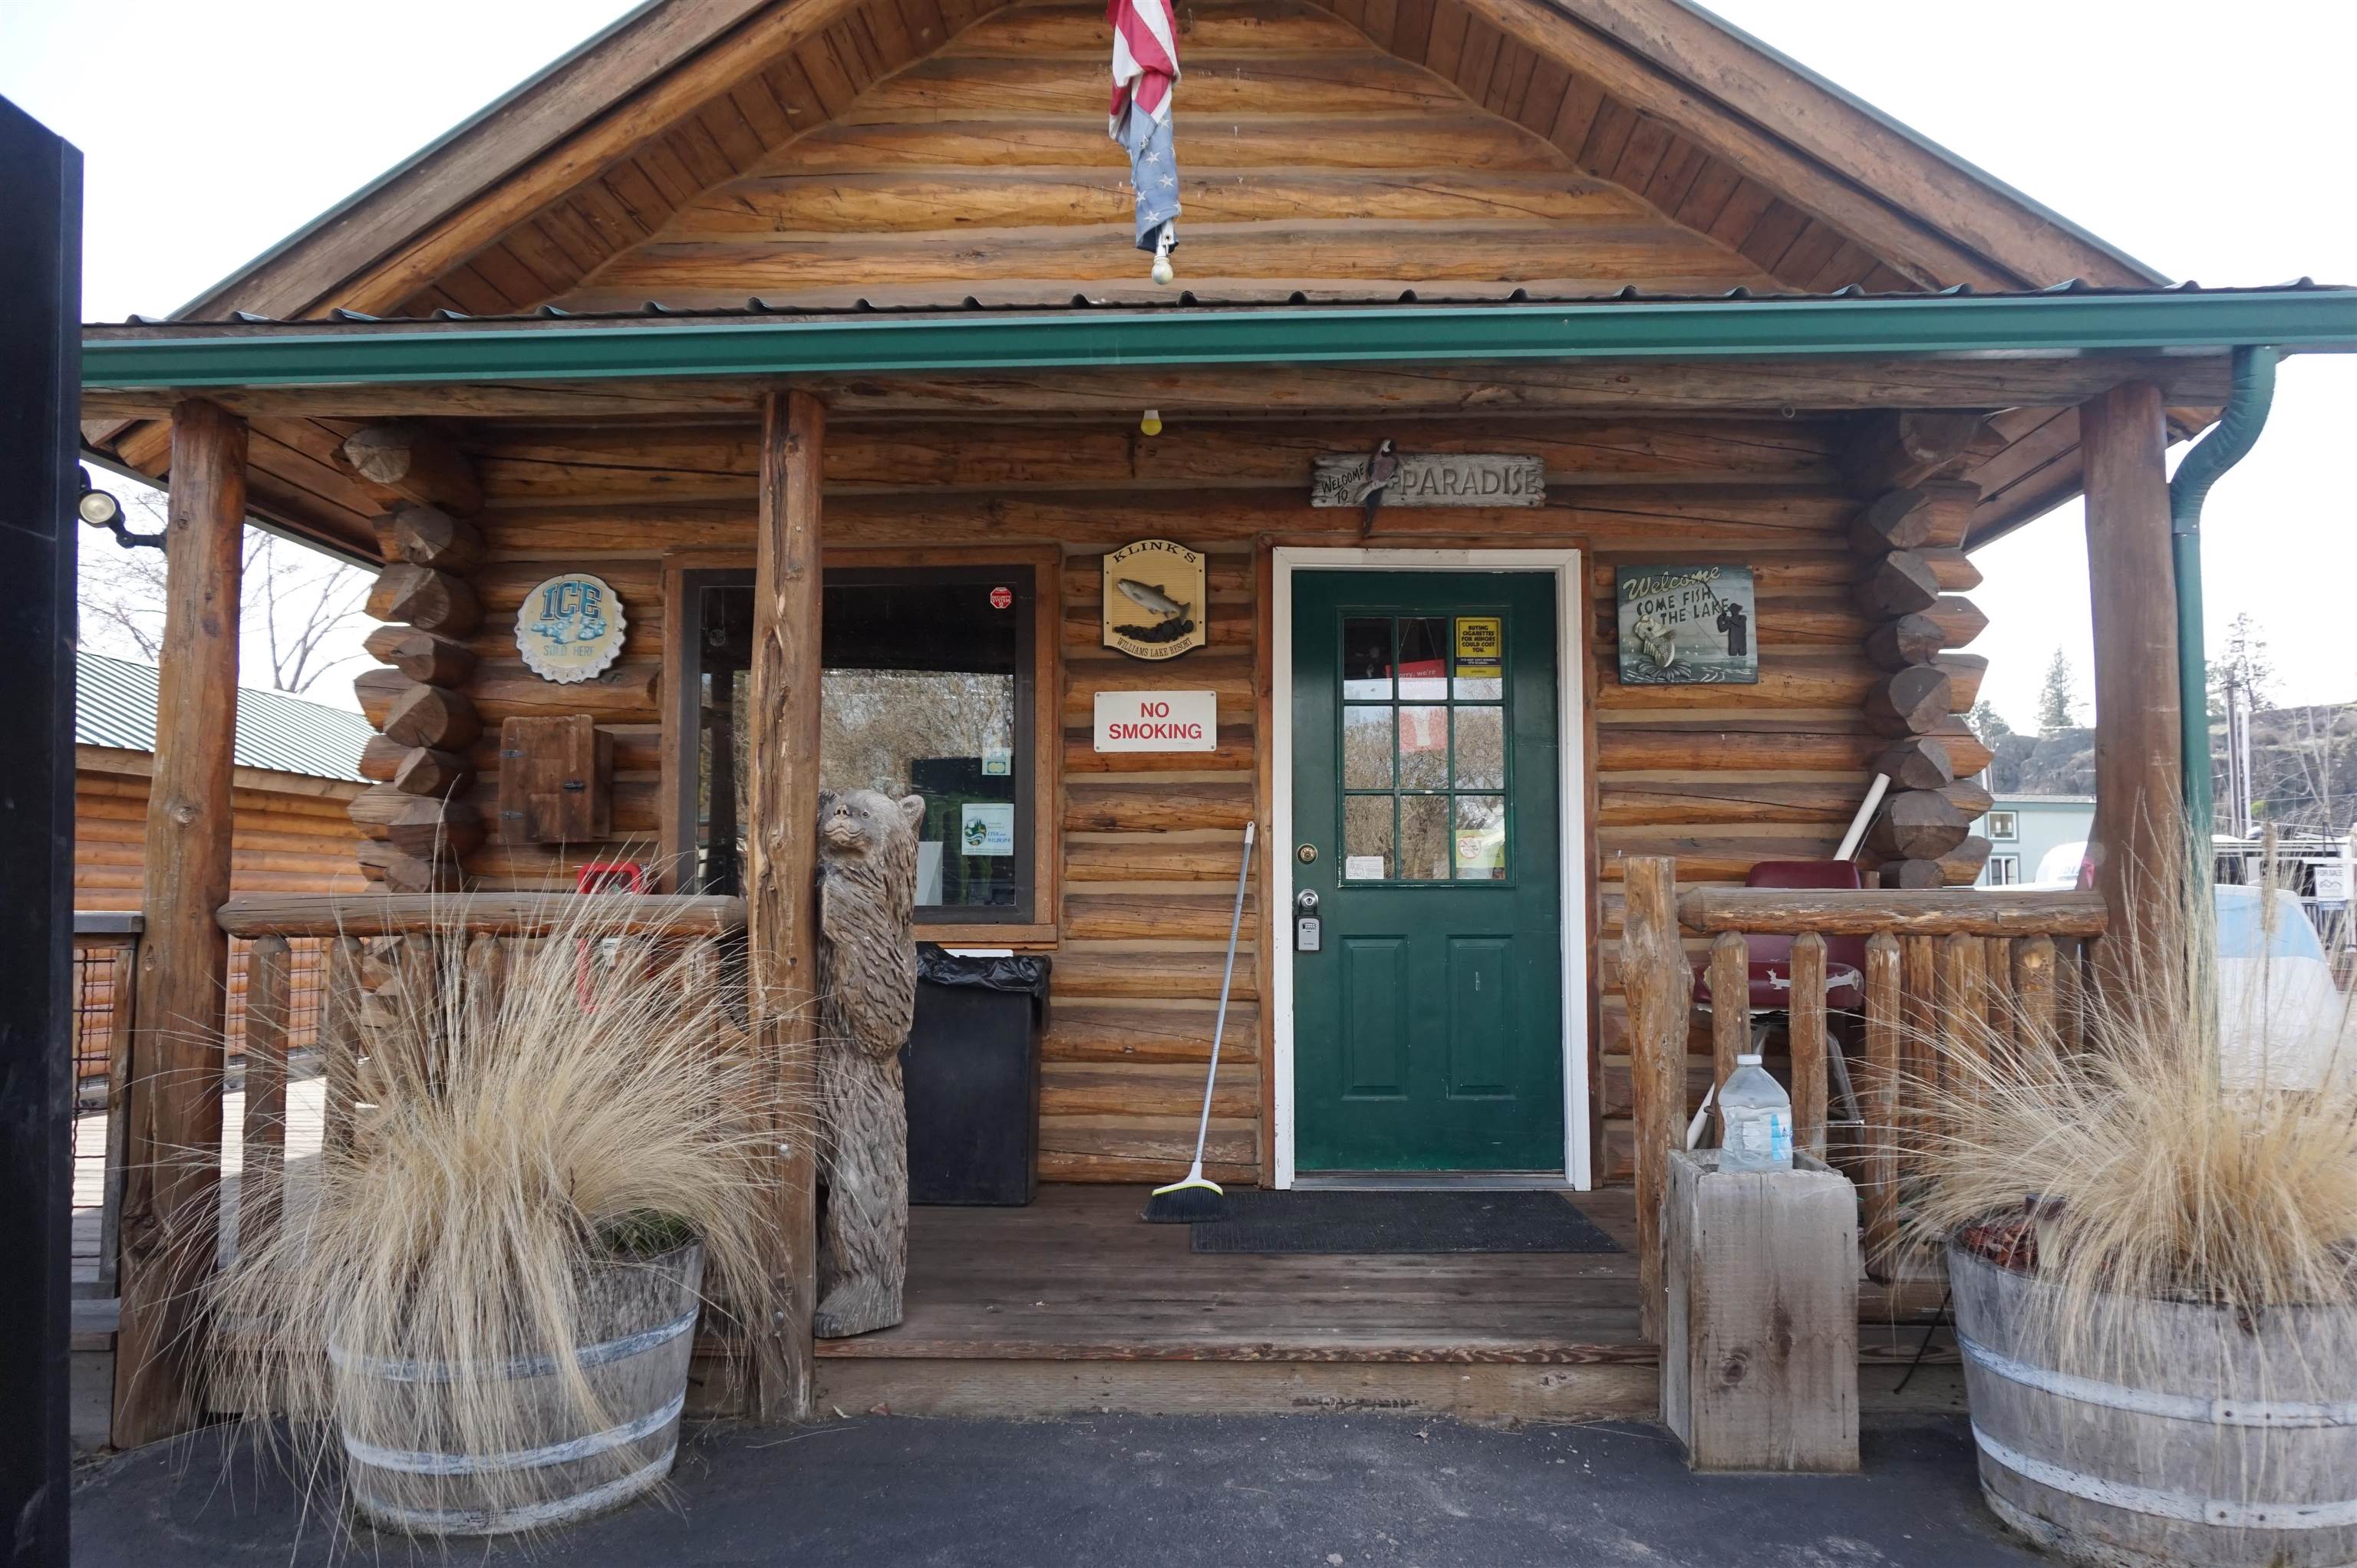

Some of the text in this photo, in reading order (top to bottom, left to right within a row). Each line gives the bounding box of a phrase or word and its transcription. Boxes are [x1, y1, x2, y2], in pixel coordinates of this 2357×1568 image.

[1321, 462, 1364, 494] WELCOME
[1399, 465, 1539, 496] PARADISE
[1334, 486, 1348, 503] TO
[1112, 542, 1196, 564] KLINK'S
[1623, 566, 1721, 601] Welcome
[540, 581, 602, 621] ICE
[1637, 587, 1711, 616] COME FISH
[1660, 598, 1729, 626] THE LAKE
[543, 645, 566, 657] SOLD
[1117, 637, 1193, 657] WILLIAMS LAKE RESORT
[1141, 702, 1169, 718] NO
[1109, 723, 1202, 740] SMOKING
